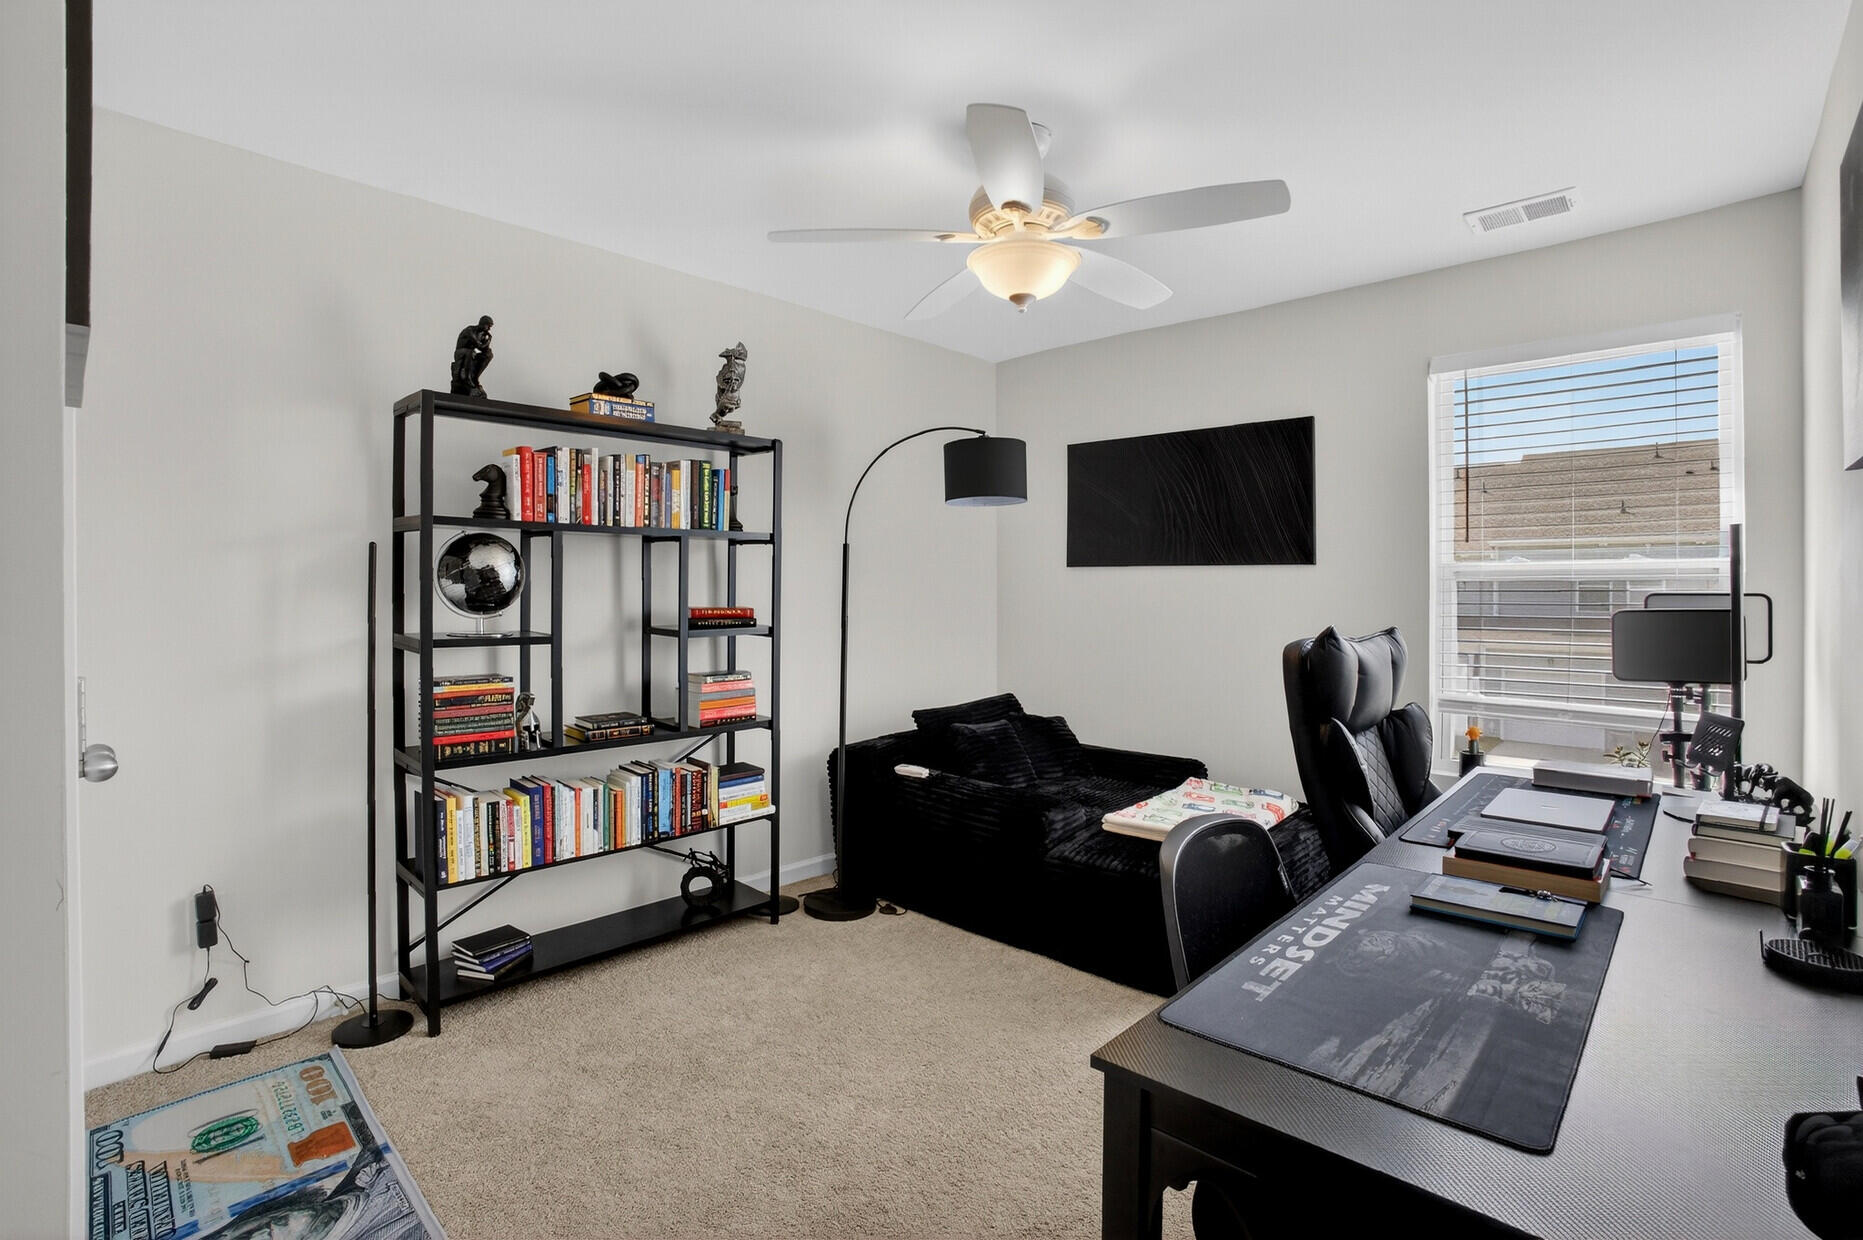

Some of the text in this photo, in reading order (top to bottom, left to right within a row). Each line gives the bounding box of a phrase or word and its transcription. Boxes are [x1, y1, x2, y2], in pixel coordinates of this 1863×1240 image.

[1241, 884, 1391, 1002] MINDSET
[1249, 895, 1344, 966] MATTERS
[299, 1065, 338, 1106] 100
[96, 1129, 125, 1170] 100
[126, 1160, 149, 1207] STATES
